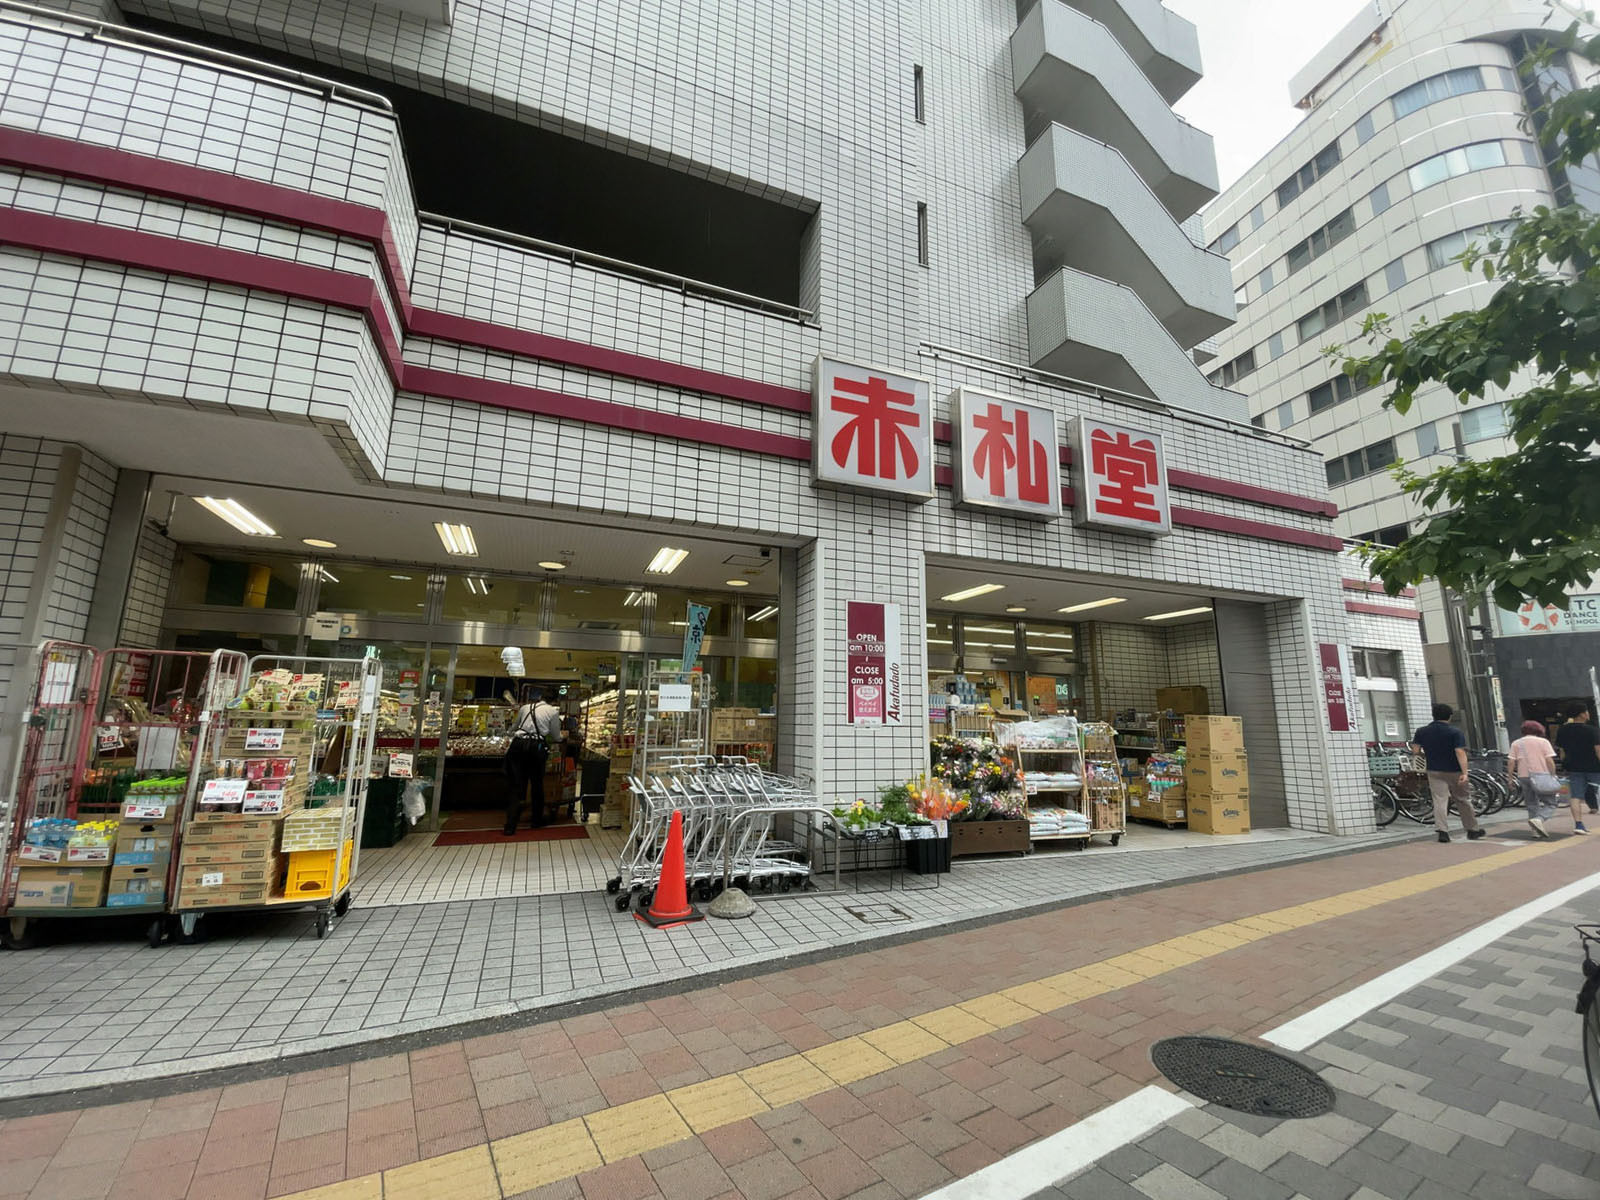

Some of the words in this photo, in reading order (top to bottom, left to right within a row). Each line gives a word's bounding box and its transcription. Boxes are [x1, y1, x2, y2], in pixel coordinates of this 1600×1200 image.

[830, 376, 1162, 524] 赤札堂
[1573, 599, 1597, 610] TC
[1563, 611, 1598, 619] DANCE
[856, 633, 877, 642] OPEN
[864, 644, 884, 652] 10:00
[855, 666, 880, 674] CLOSE
[867, 677, 884, 685] 5:00
[888, 662, 900, 722] Akafudado
